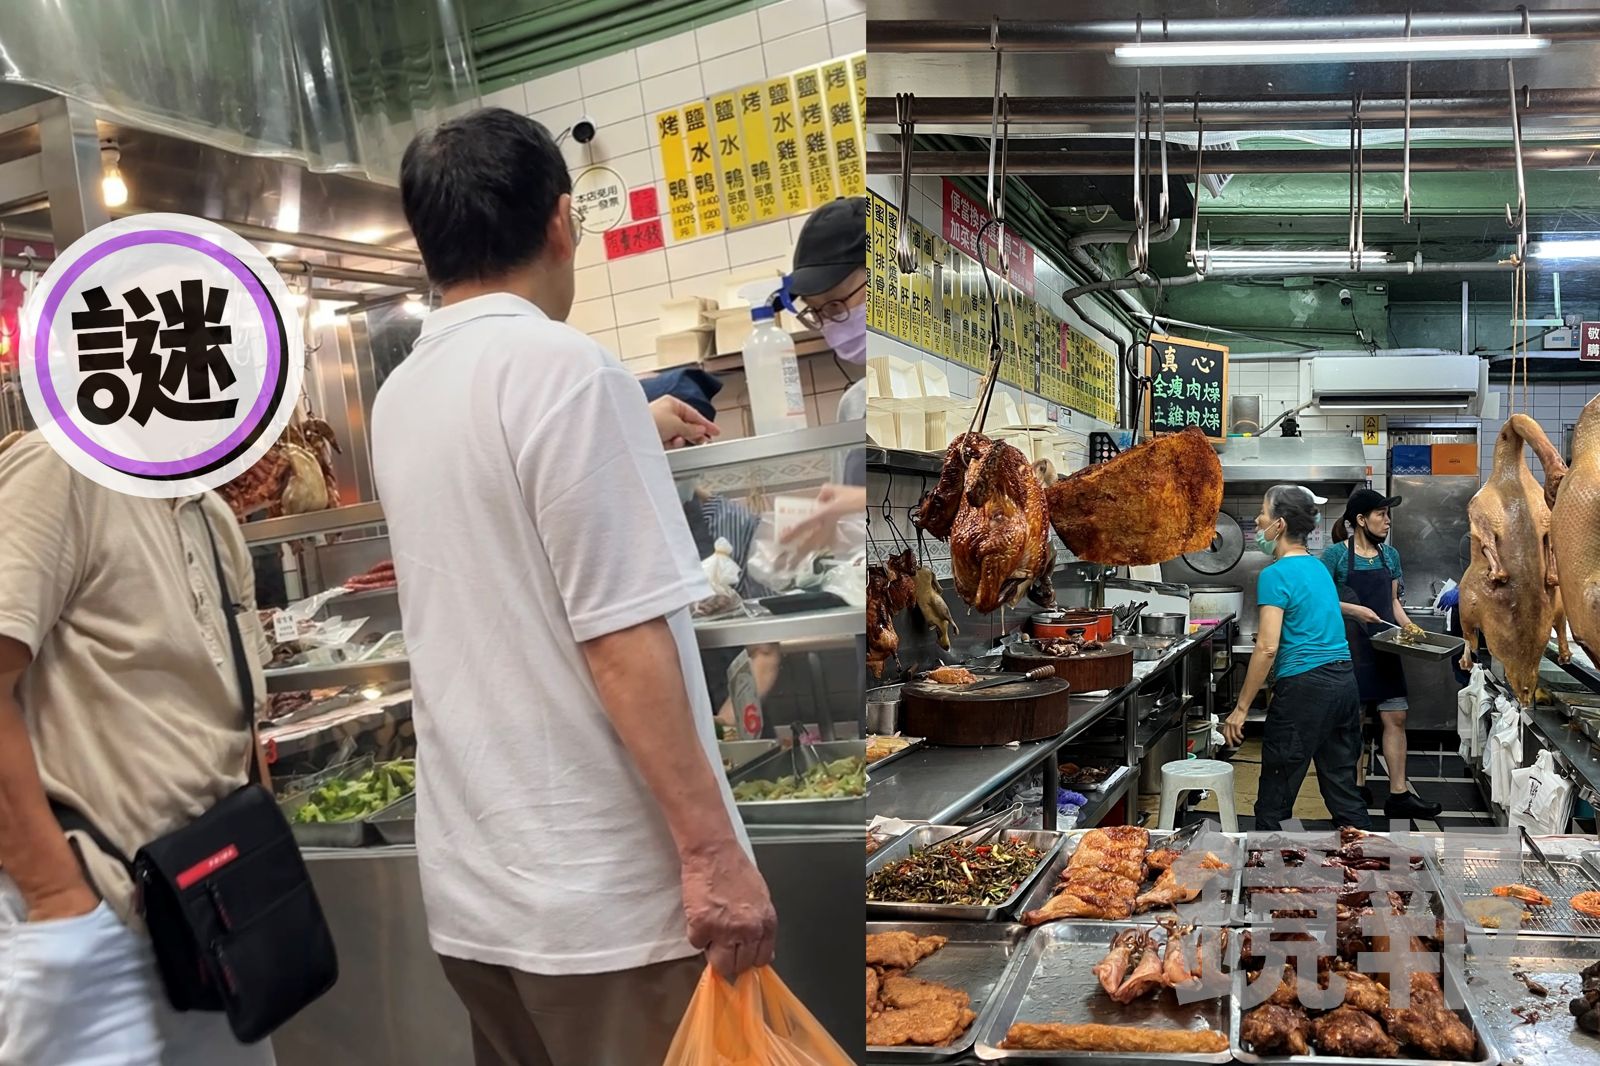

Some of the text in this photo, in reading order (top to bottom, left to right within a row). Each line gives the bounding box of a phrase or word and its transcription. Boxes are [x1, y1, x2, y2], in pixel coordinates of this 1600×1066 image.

[659, 114, 689, 201] 烤鴨
[685, 107, 715, 195] 鹽水鴨
[714, 95, 745, 190] 鹽水鴨
[741, 91, 771, 184] 烤鴨
[760, 196, 775, 207] 700
[768, 83, 798, 161] 鹽水雞
[788, 190, 799, 200] 42
[797, 74, 827, 155] 鹽烤雞
[816, 183, 830, 193] 45
[825, 65, 858, 161] 烤雞腿
[842, 175, 860, 186] 120
[875, 202, 884, 296] 蜜汁排骨
[888, 210, 897, 301] 蜜汁叉燒肉
[1153, 373, 1221, 403] 全瘦肉燥
[1162, 345, 1215, 373] 真心
[1154, 402, 1221, 430] 土雞肉燥
[1367, 417, 1375, 440] 公休
